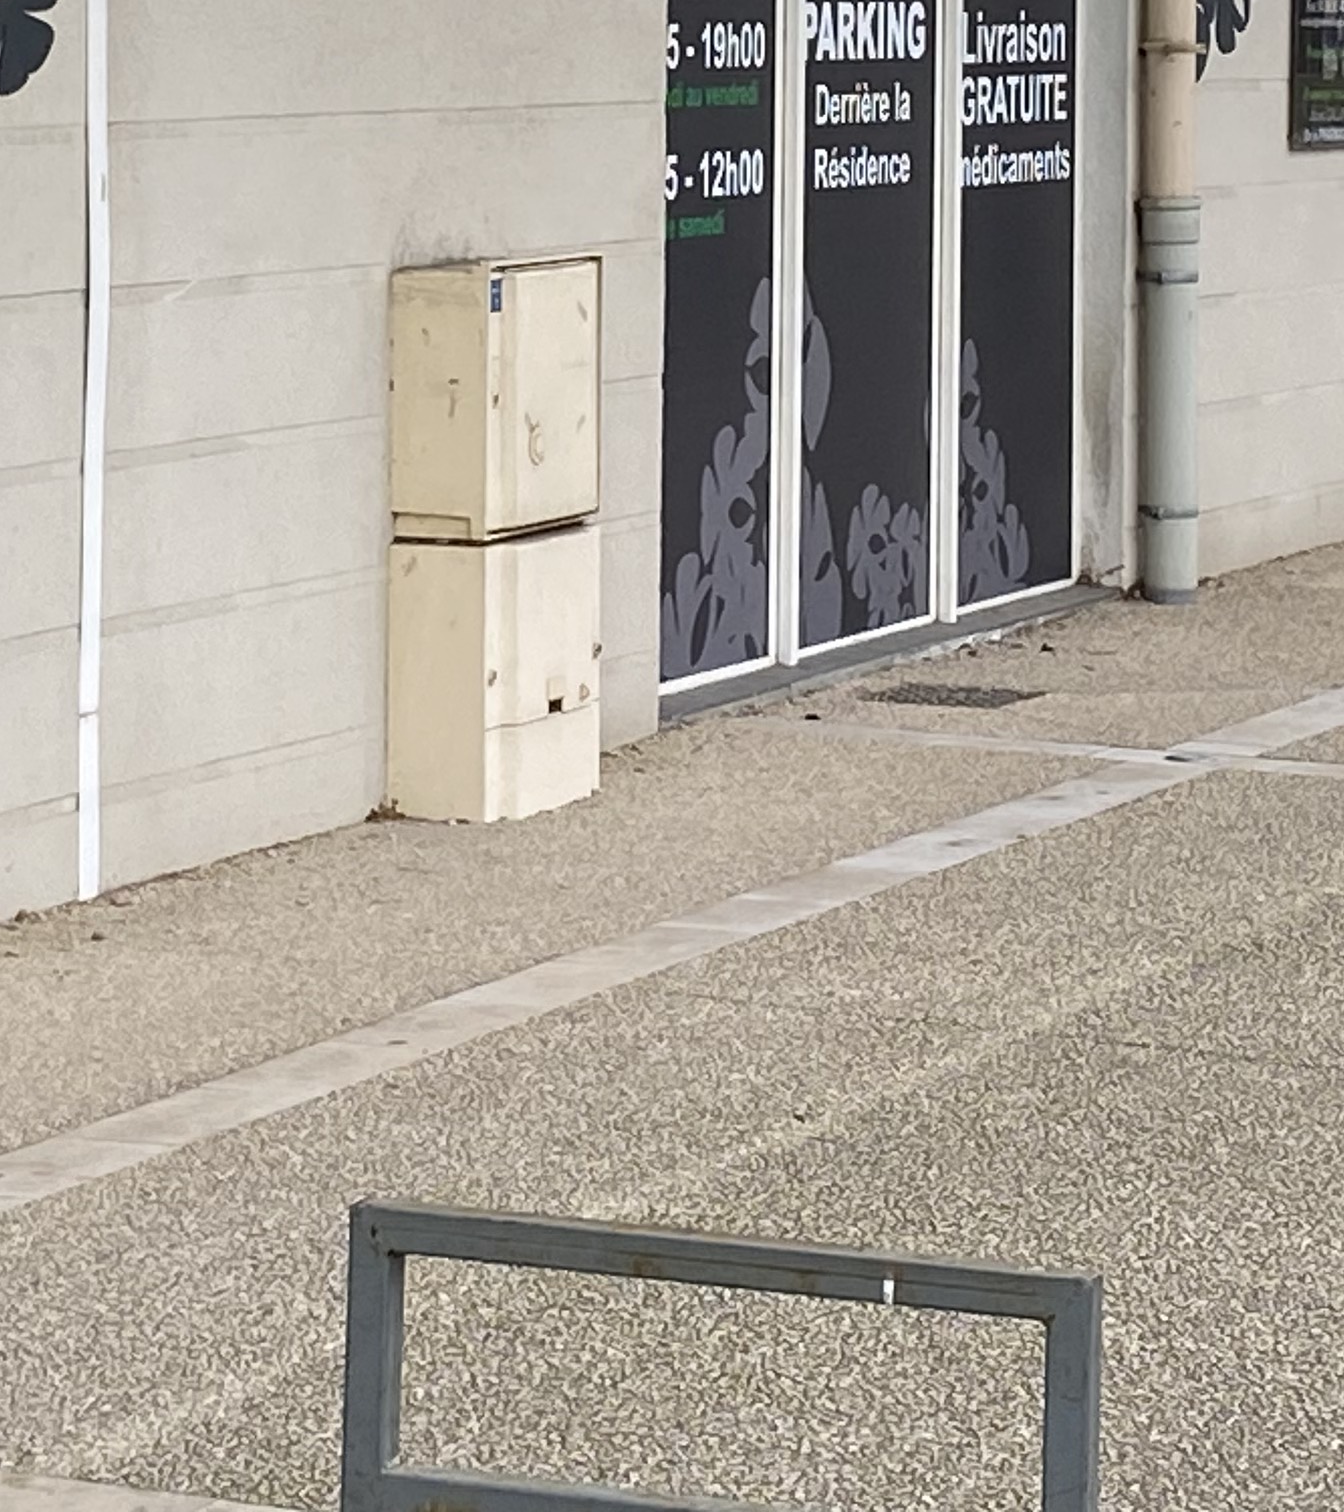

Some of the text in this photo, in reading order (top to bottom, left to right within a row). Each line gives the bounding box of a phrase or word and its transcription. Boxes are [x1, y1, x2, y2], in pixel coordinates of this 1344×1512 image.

[701, 21, 766, 70] 19h00
[805, 1, 927, 62] PARKING
[962, 9, 1067, 65] Livraison
[815, 81, 911, 126] Derrière la
[961, 73, 1068, 126] GRATUITE
[699, 148, 764, 199] 12h00
[814, 144, 912, 190] Résidence
